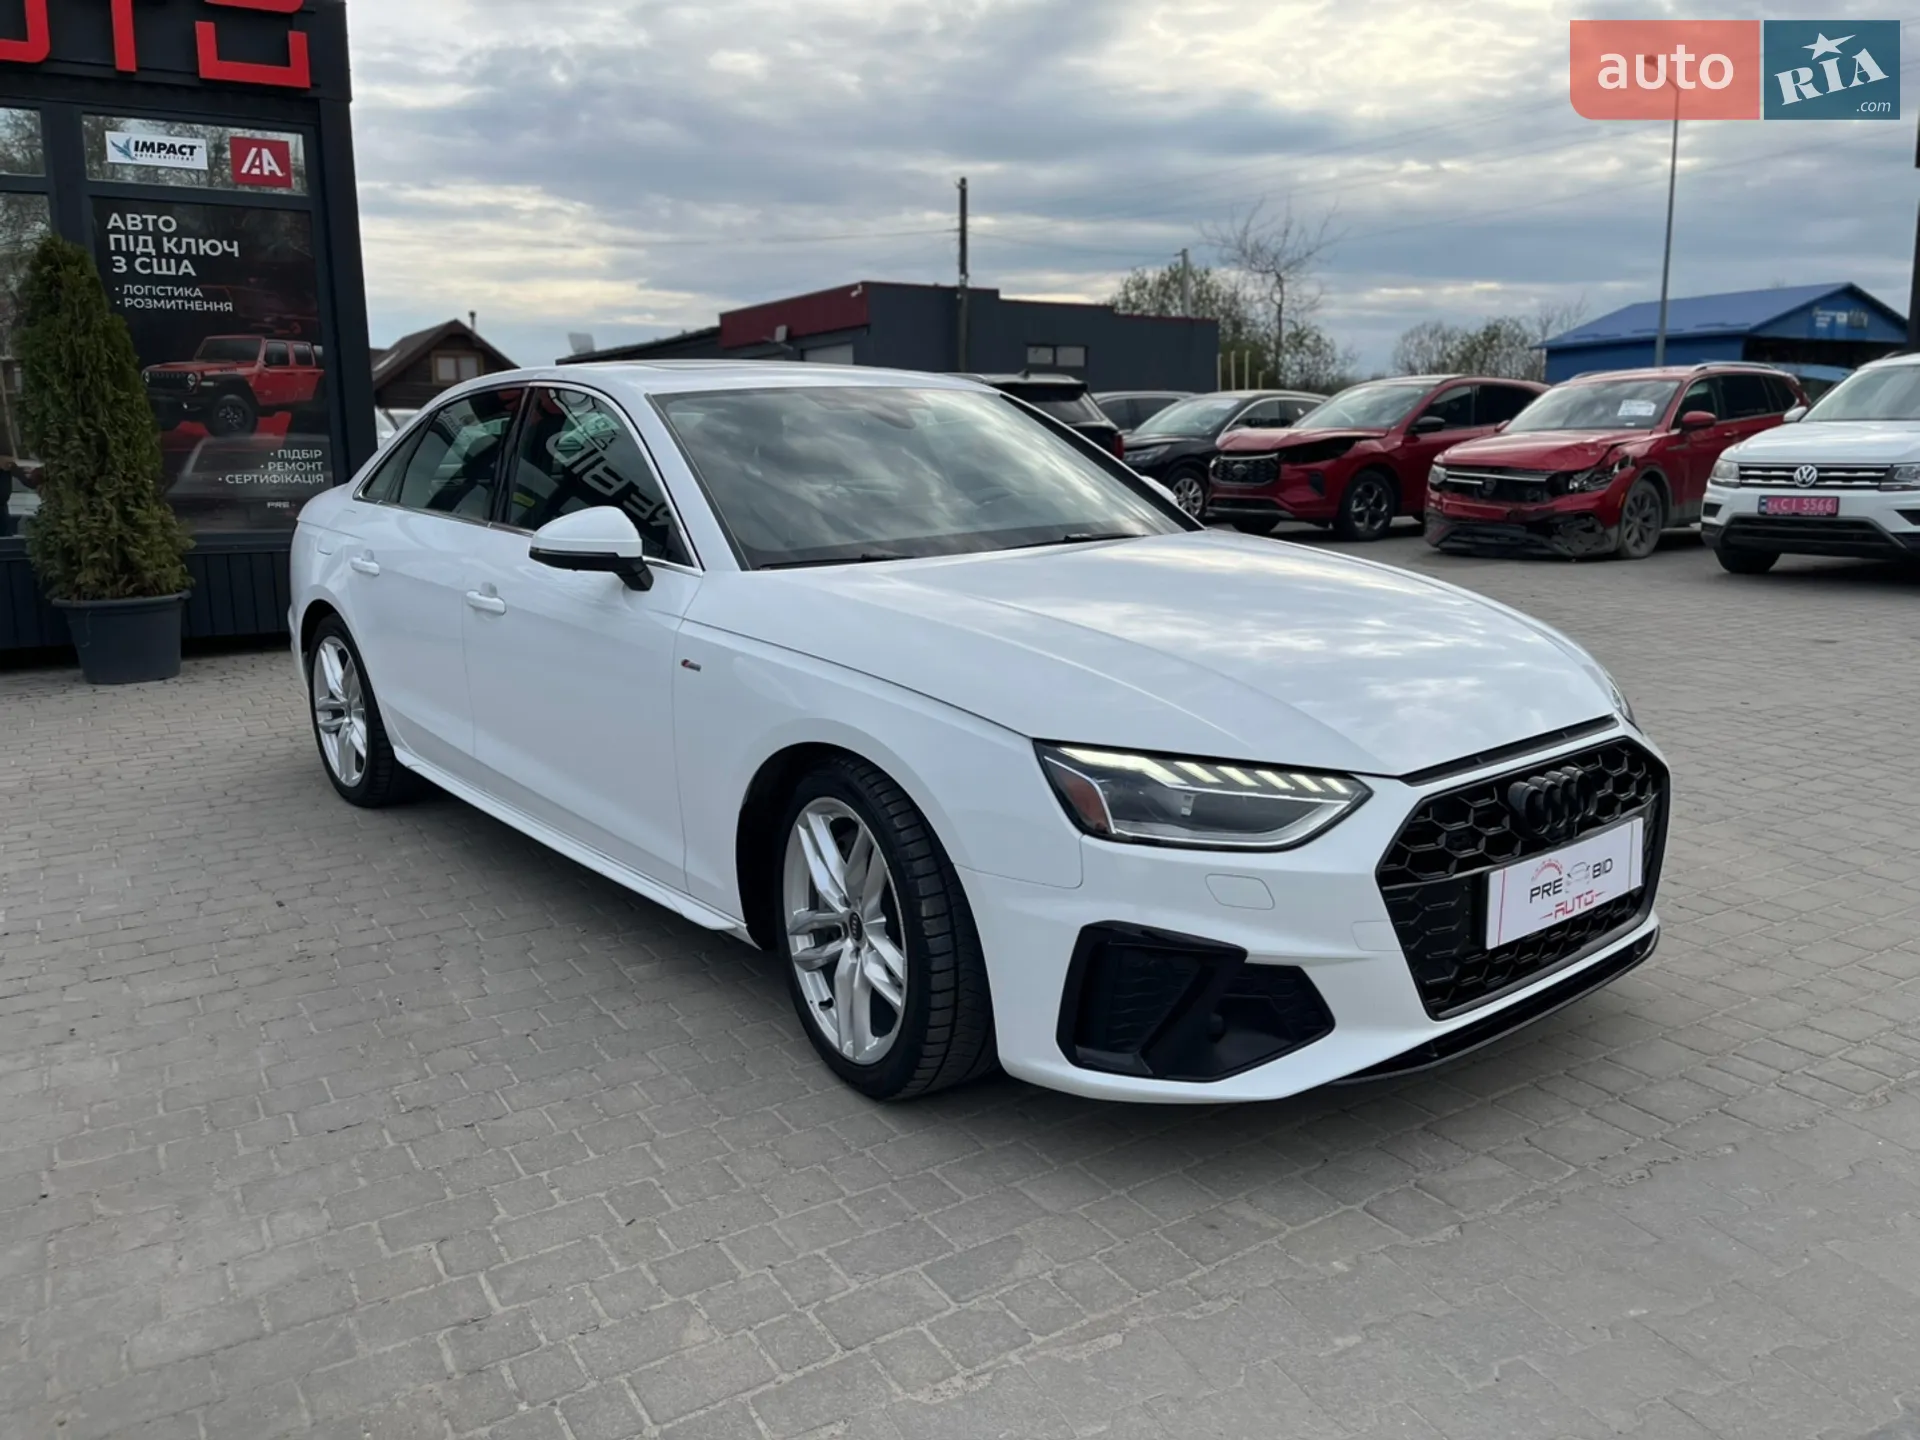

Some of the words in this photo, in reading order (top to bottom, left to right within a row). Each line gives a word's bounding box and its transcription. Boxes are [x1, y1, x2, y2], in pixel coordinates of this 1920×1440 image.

[133, 140, 197, 156] IMPACT
[106, 212, 177, 232] АВТО
[108, 233, 156, 256] ПІД
[162, 237, 239, 258] КЛЮЧ
[112, 256, 127, 274] З
[134, 257, 197, 277] США
[123, 284, 203, 298] ЛОГІСТИКА
[124, 298, 233, 313] РОЗМИТНЕННЯ
[277, 449, 323, 461] ПІДБІР
[267, 461, 323, 472] РЕМОНТ
[225, 473, 324, 485] СЕРТИФІКАЦІЯ
[1802, 498, 1832, 511] 5566
[1529, 878, 1563, 904] PRE
[1591, 858, 1613, 879] BID
[1554, 890, 1595, 919] AUTO
